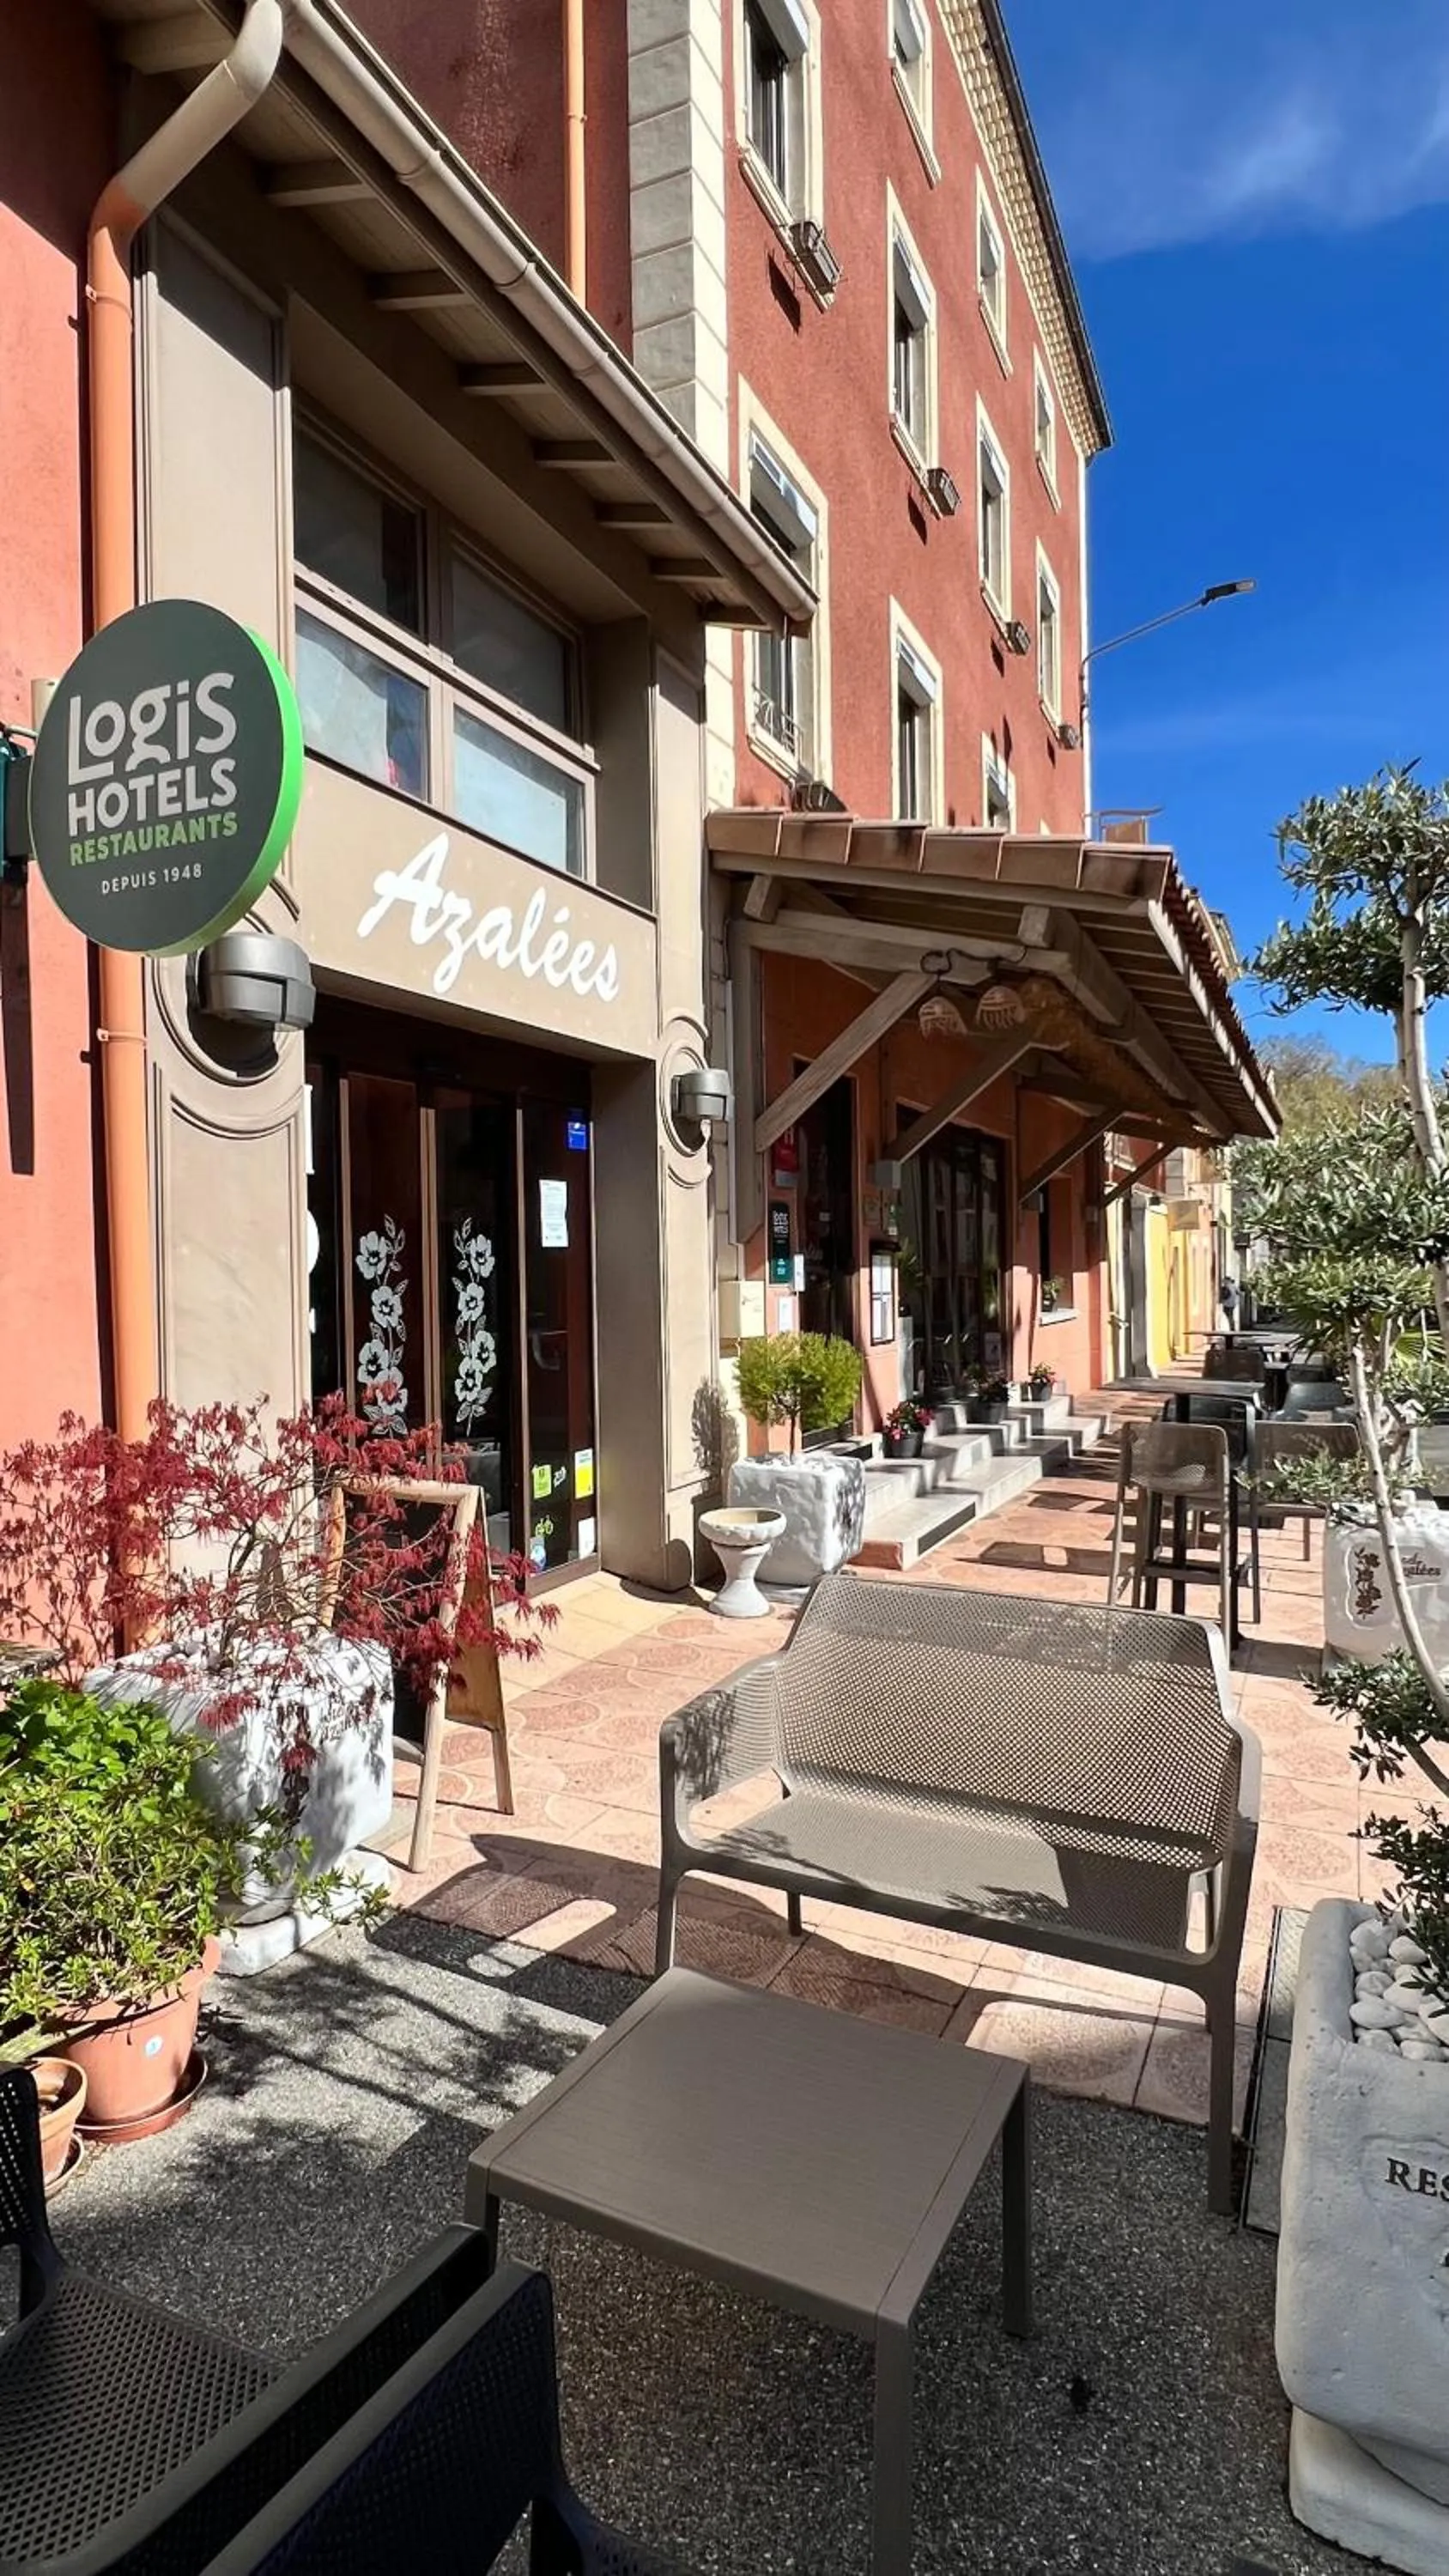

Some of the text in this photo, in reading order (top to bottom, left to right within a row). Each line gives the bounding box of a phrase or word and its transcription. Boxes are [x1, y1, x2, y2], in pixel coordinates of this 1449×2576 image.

[69, 758, 238, 837] HOTELS
[70, 811, 239, 866] RESTAURANTS
[101, 863, 203, 895] DEPUIS 1948
[356, 831, 620, 1002] Azalées
